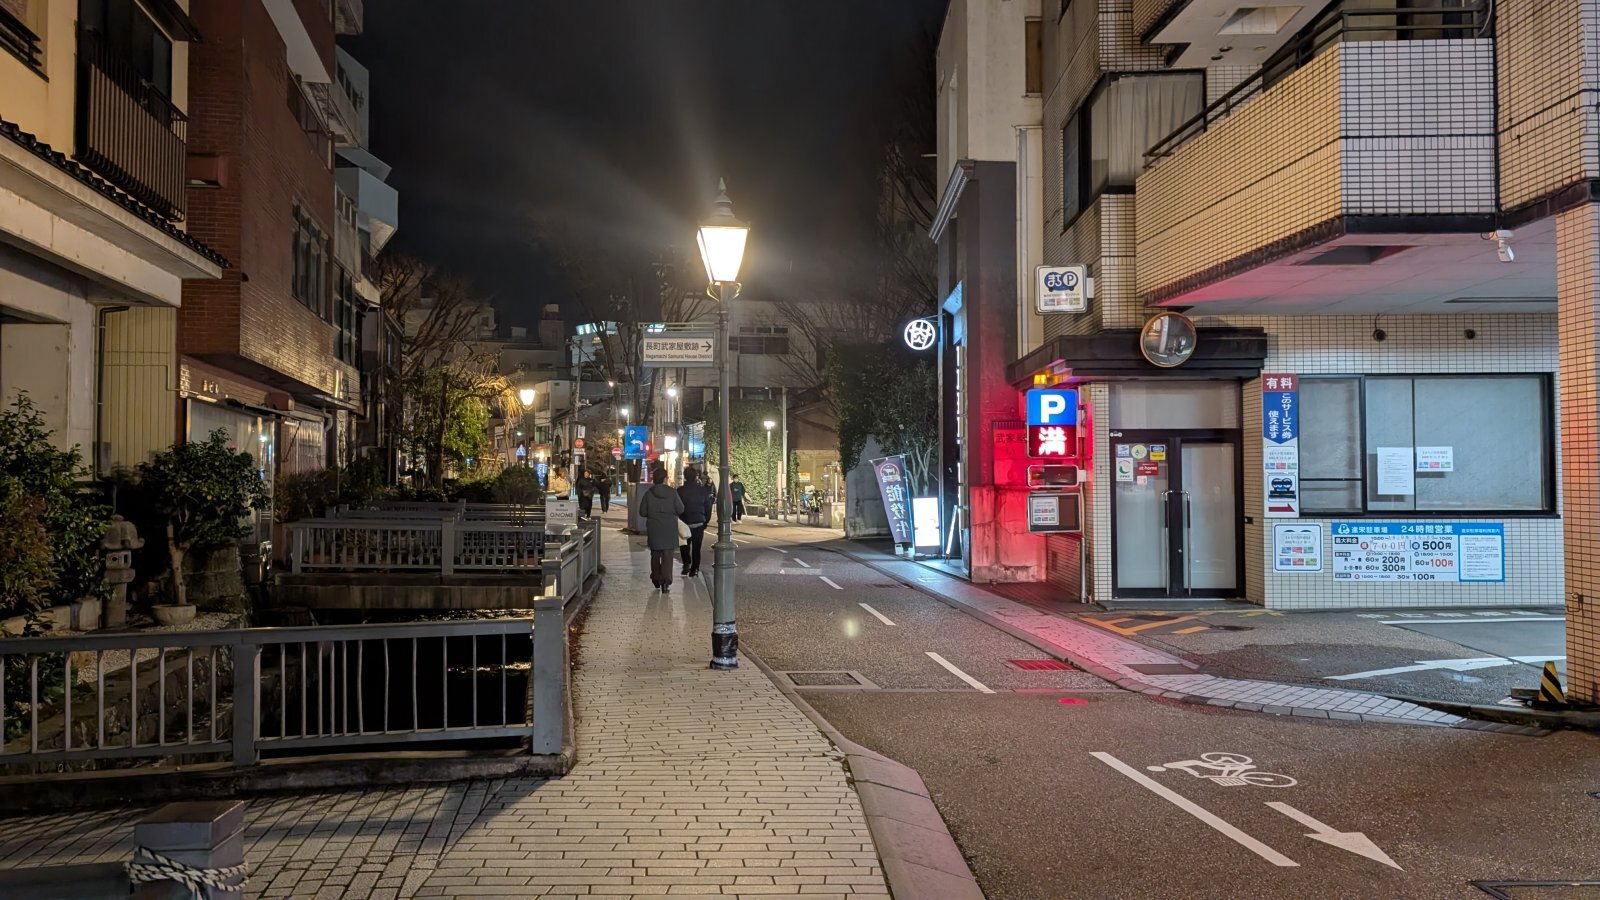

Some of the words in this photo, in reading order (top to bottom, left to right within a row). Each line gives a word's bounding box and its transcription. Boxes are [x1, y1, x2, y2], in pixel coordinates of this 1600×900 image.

[645, 341, 700, 351] 長町武家屋敷跡
[1266, 377, 1293, 389] 有料
[1040, 394, 1066, 424] P
[1281, 393, 1293, 439] このサービス券
[1268, 410, 1280, 439] 使えます
[629, 429, 636, 437] P
[1038, 426, 1067, 456] 満
[1400, 524, 1454, 534] 24時間営業
[1422, 540, 1452, 550] 500円
